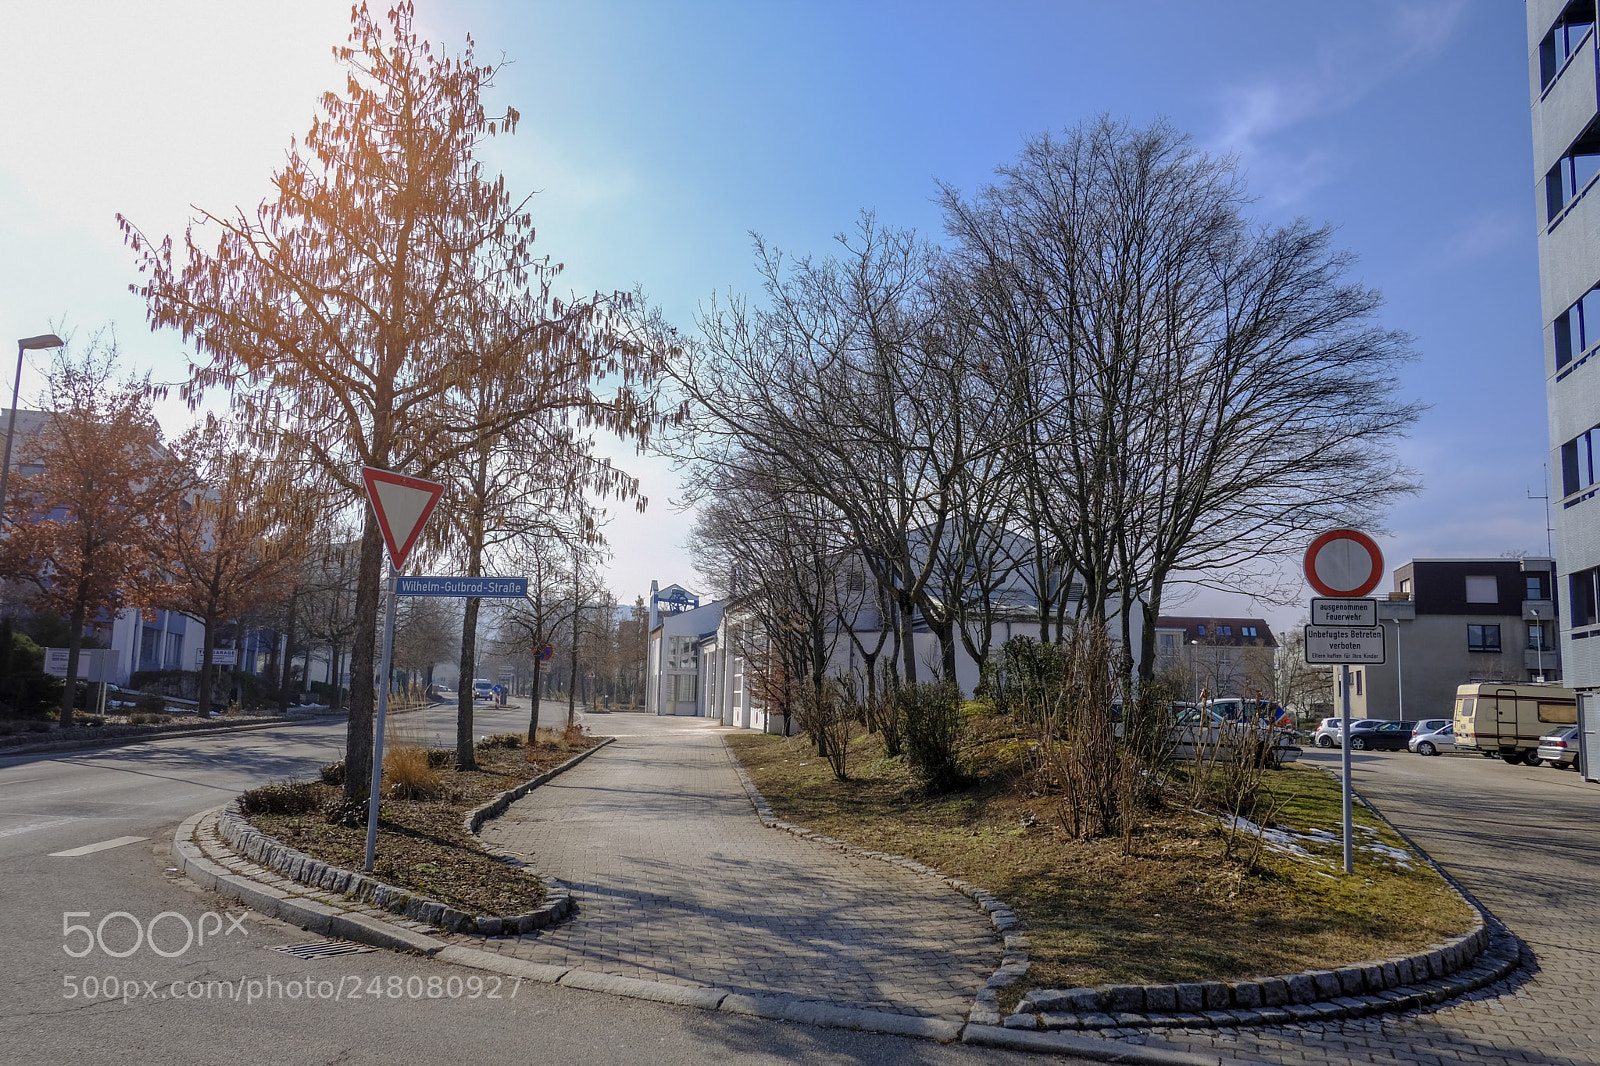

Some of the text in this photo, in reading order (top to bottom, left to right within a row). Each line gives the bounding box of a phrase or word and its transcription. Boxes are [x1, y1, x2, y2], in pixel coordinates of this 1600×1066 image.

[402, 580, 521, 593] Wilhelm-Gutbrod-Straße
[1320, 604, 1368, 612] ausgenommen
[1325, 613, 1362, 621] Feuerwehr
[1308, 630, 1382, 640] Unbefugtes Betreten
[1329, 642, 1361, 650] verboten
